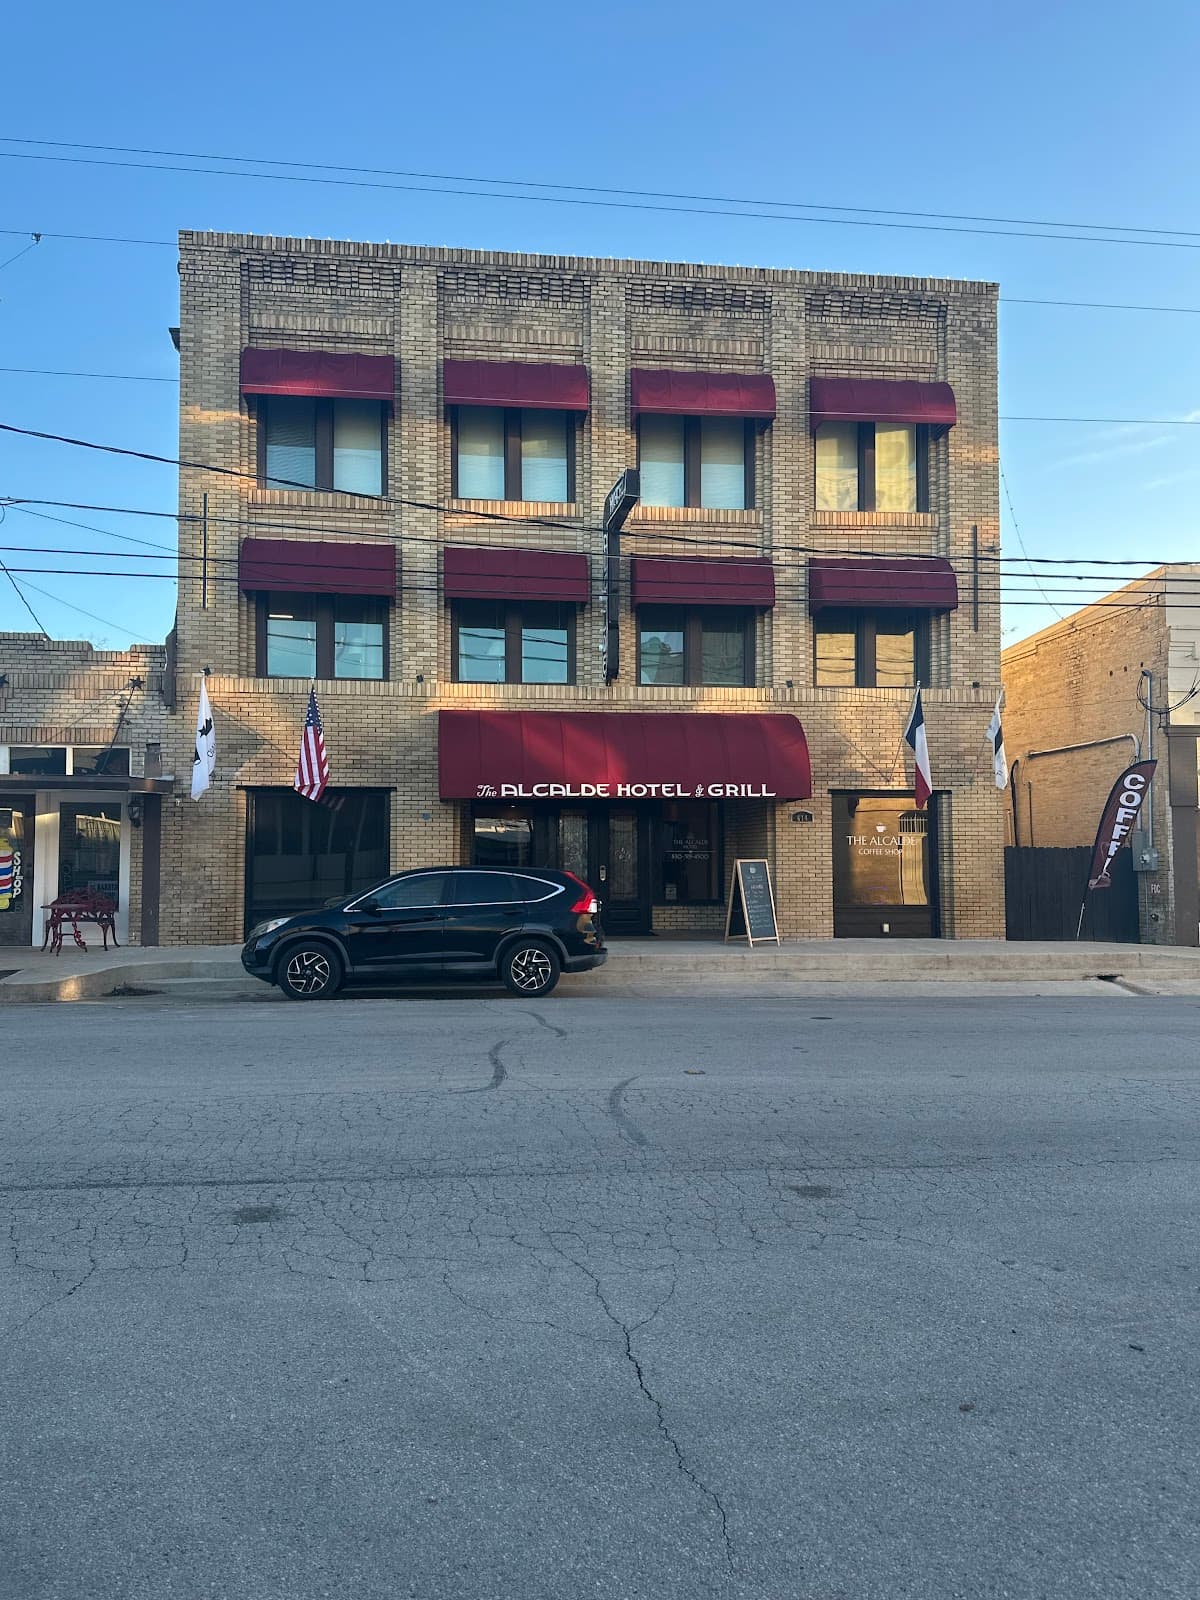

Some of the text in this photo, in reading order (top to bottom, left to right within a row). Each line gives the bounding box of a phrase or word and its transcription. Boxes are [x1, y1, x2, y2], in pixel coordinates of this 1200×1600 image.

[477, 783, 777, 798] The ALCALDE HOTEL & GRILL
[846, 835, 917, 846] THE ALCALDE
[858, 848, 903, 856] COFFEE SHOP
[12, 851, 22, 899] SHOP
